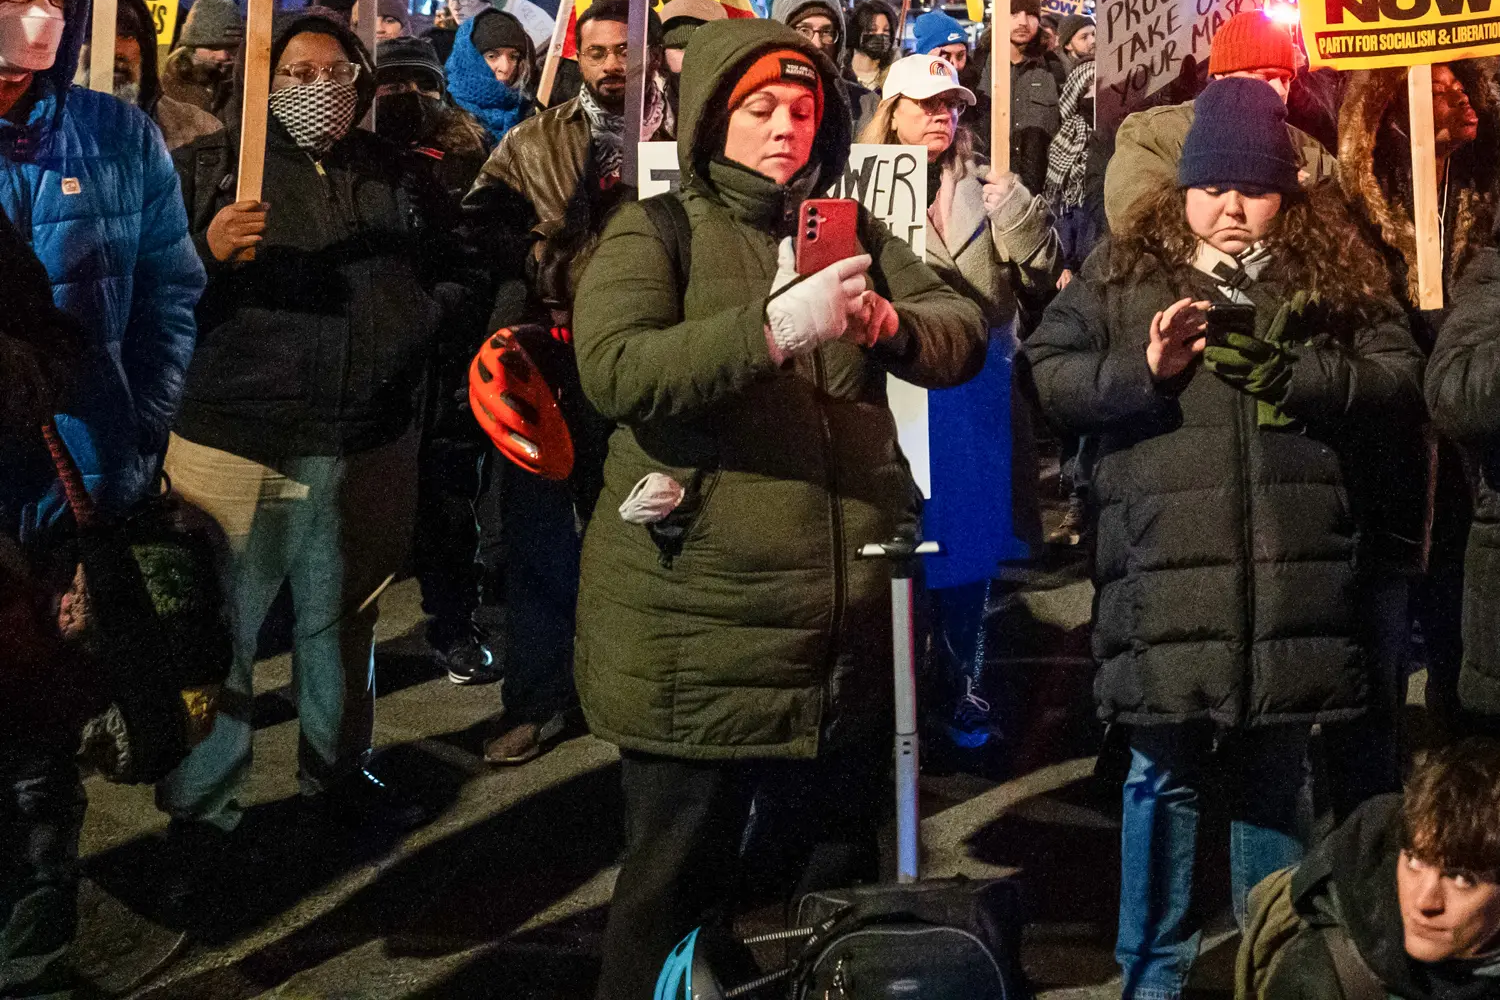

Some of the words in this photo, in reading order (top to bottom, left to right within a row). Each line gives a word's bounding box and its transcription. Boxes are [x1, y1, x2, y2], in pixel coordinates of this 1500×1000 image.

[1109, 3, 1182, 73] TAKE
[1318, 35, 1354, 55] PARTY
[1355, 34, 1379, 51] FOR
[1379, 29, 1436, 50] SOCIALISM
[1438, 29, 1451, 45] &
[1110, 40, 1182, 102] YOUR
[832, 153, 917, 222] WER
